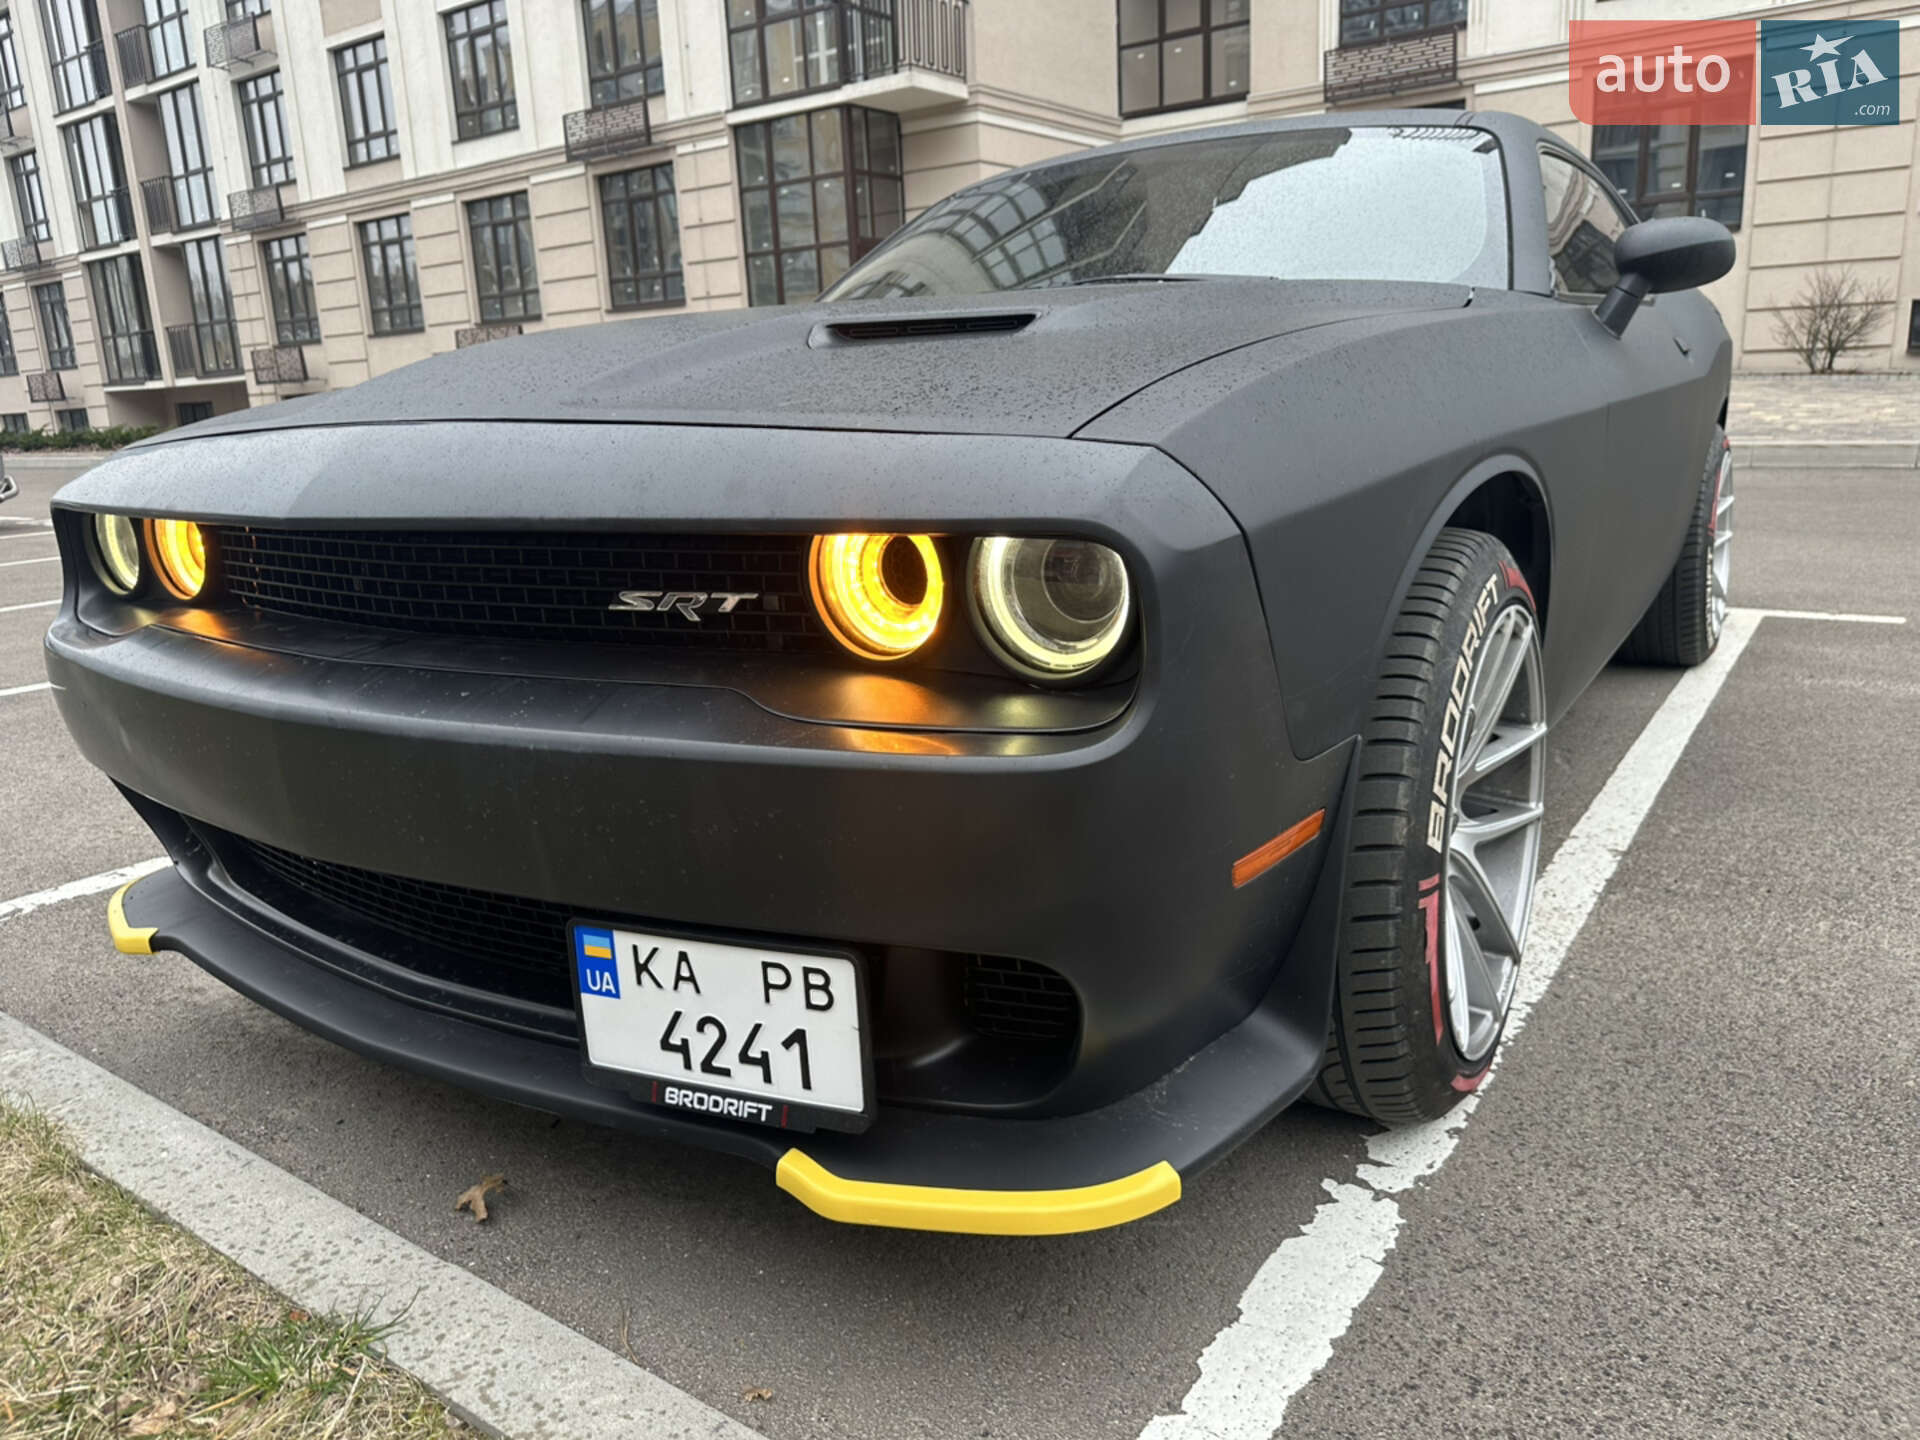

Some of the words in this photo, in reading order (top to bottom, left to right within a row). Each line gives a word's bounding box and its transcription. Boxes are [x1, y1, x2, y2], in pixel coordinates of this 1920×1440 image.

[608, 590, 759, 622] SRT
[1426, 573, 1499, 854] BRODRIFT
[586, 968, 616, 994] UA
[632, 944, 701, 995] KA
[761, 960, 834, 1012] PB
[660, 1010, 812, 1091] 4241
[664, 1086, 773, 1122] BRODRIFT
